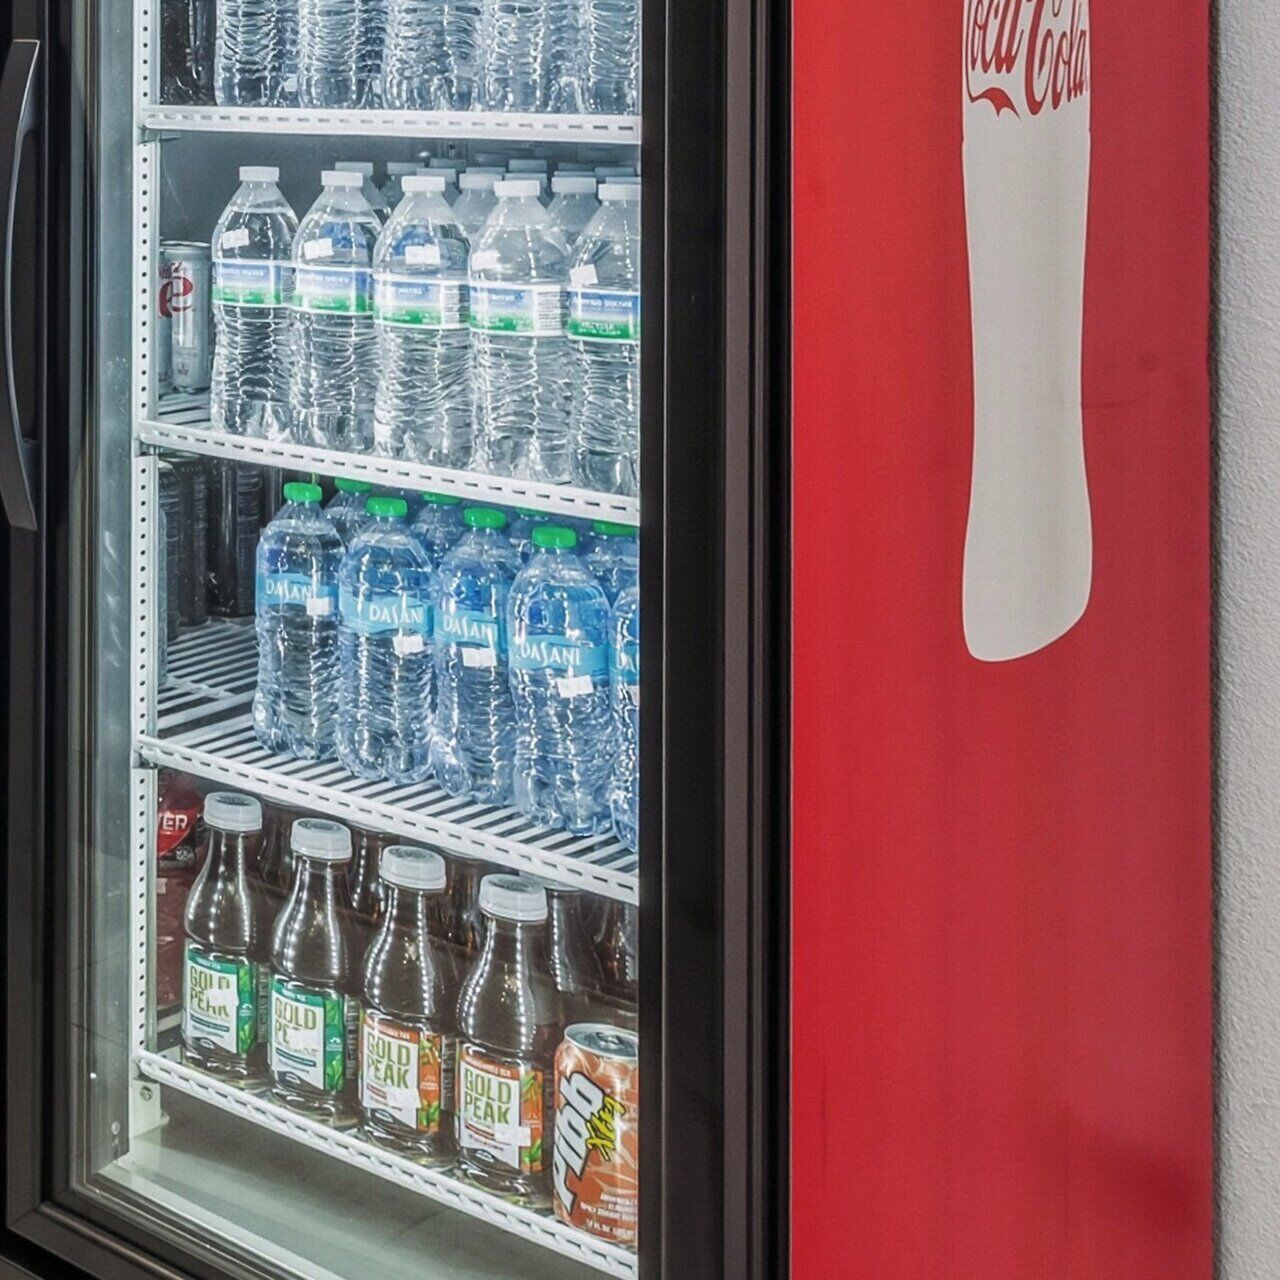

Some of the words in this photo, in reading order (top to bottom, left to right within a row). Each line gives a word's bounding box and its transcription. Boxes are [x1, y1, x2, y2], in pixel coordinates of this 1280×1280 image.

[519, 642, 581, 666] DASANI
[275, 997, 317, 1030] GOLD
[367, 1032, 411, 1068] GOLD
[366, 1054, 410, 1089] PEAK
[464, 1067, 512, 1105] GOLD
[464, 1090, 510, 1124] PEAK
[553, 1071, 605, 1215] Pibb
